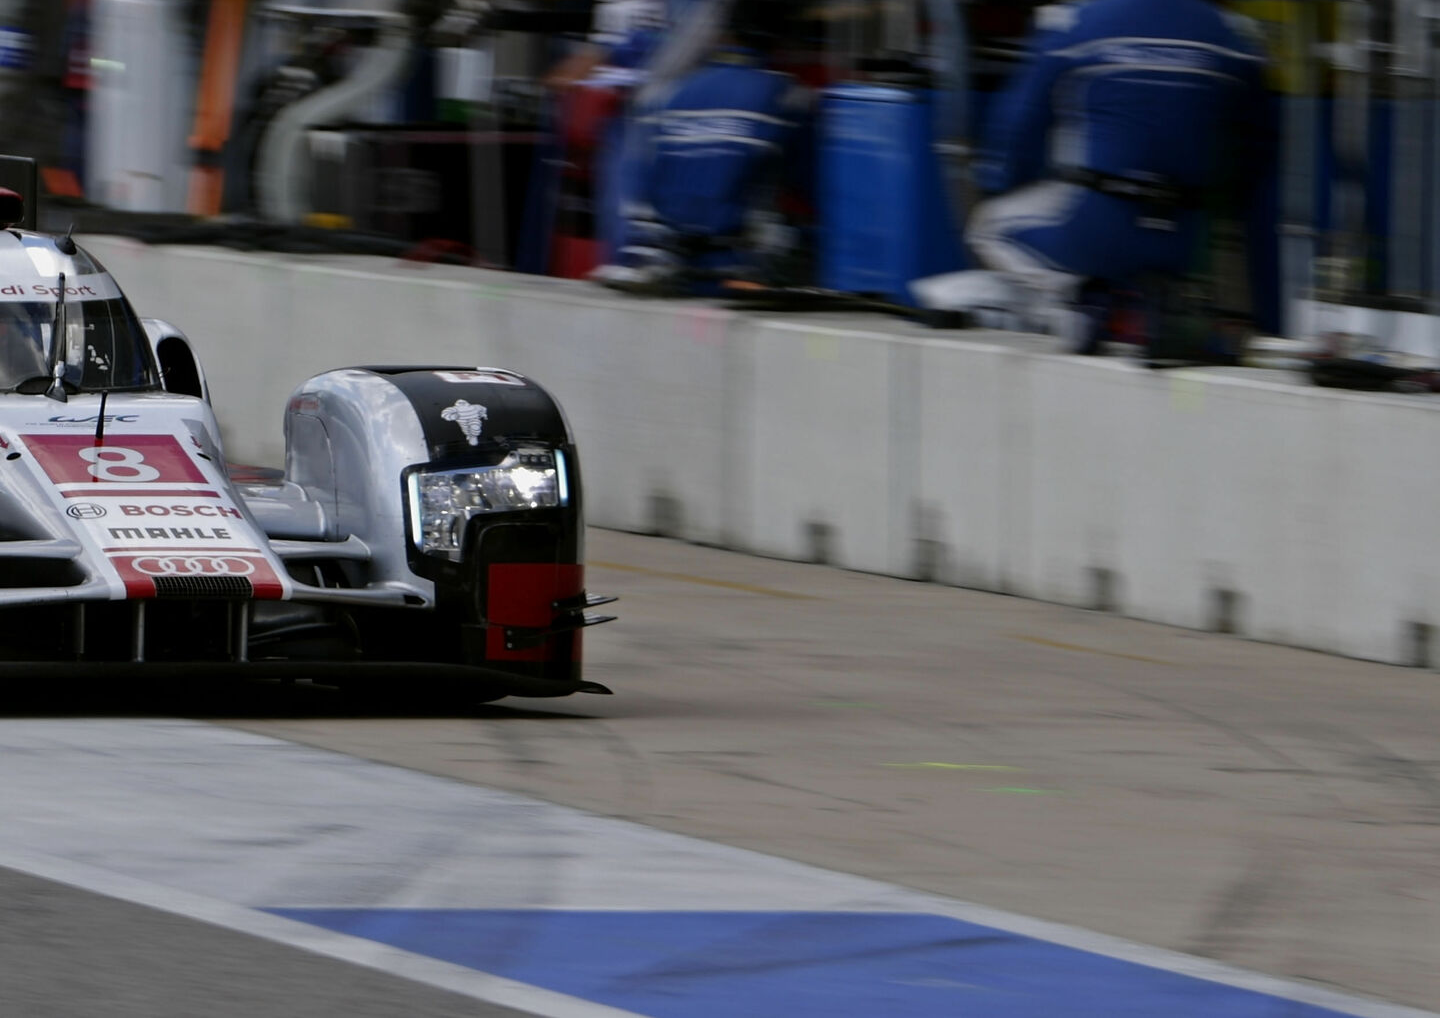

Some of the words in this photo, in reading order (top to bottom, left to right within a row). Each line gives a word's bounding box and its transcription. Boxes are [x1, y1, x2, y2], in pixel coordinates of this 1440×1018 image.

[32, 285, 97, 296] Sport
[78, 446, 160, 482] 8
[120, 505, 243, 519] BOSCH
[108, 527, 232, 540] MAHLE
